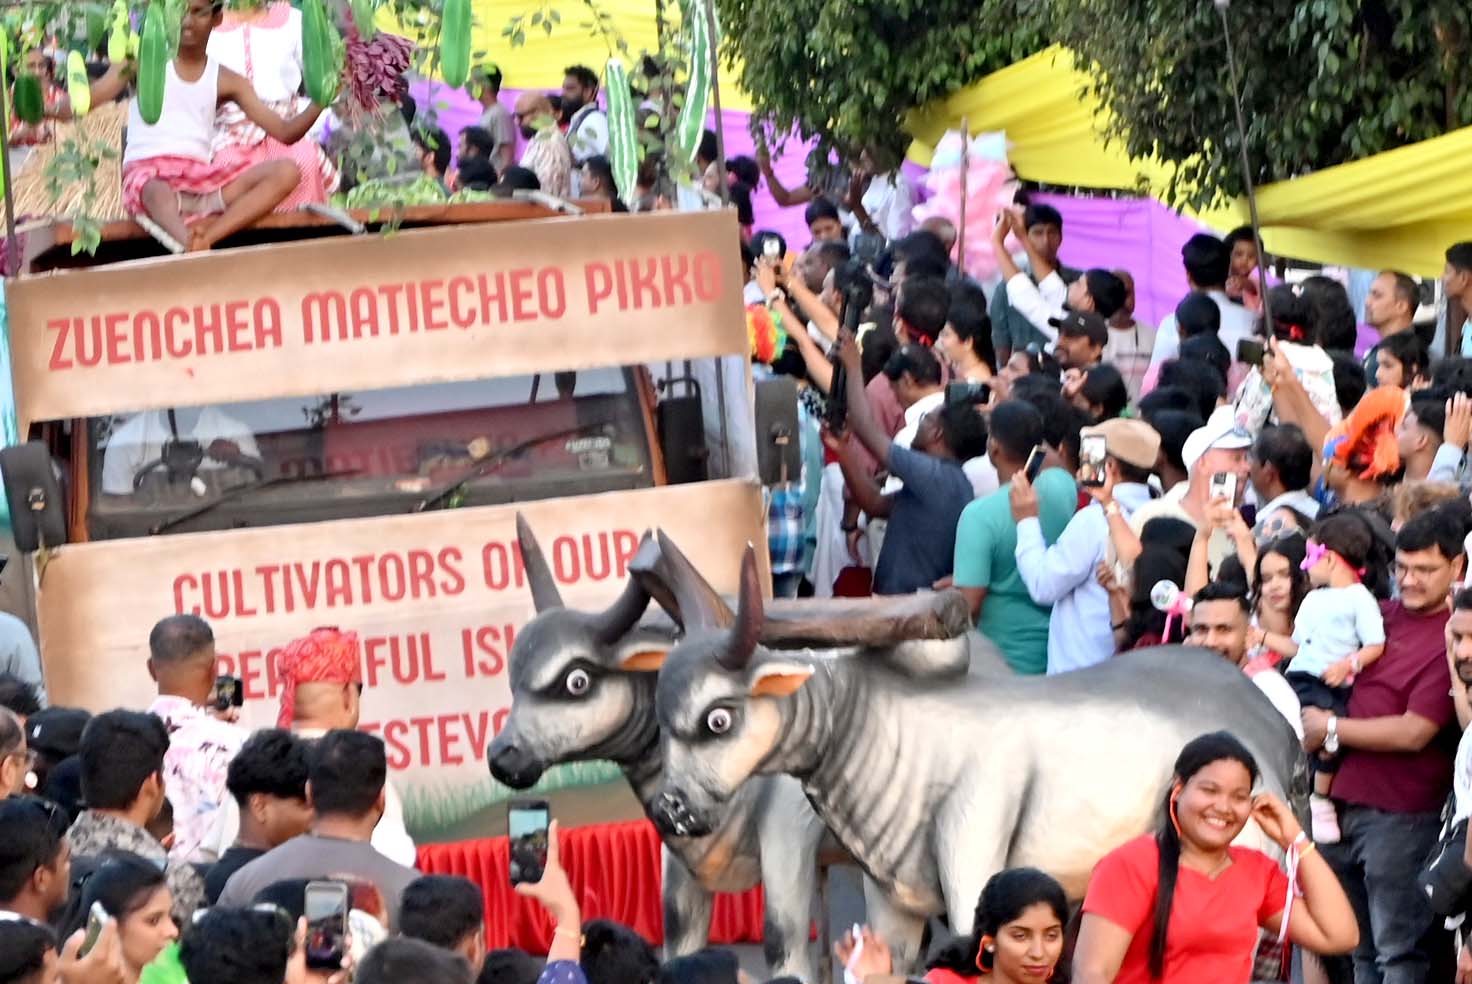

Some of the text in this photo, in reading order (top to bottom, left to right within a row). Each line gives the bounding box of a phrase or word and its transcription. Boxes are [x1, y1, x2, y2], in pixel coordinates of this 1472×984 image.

[46, 249, 724, 372] ZUENCHEA MATIECHEO PIKKO
[173, 546, 466, 619] CULTIVATORS
[552, 529, 638, 585] OUR
[214, 630, 446, 700] EAFUL
